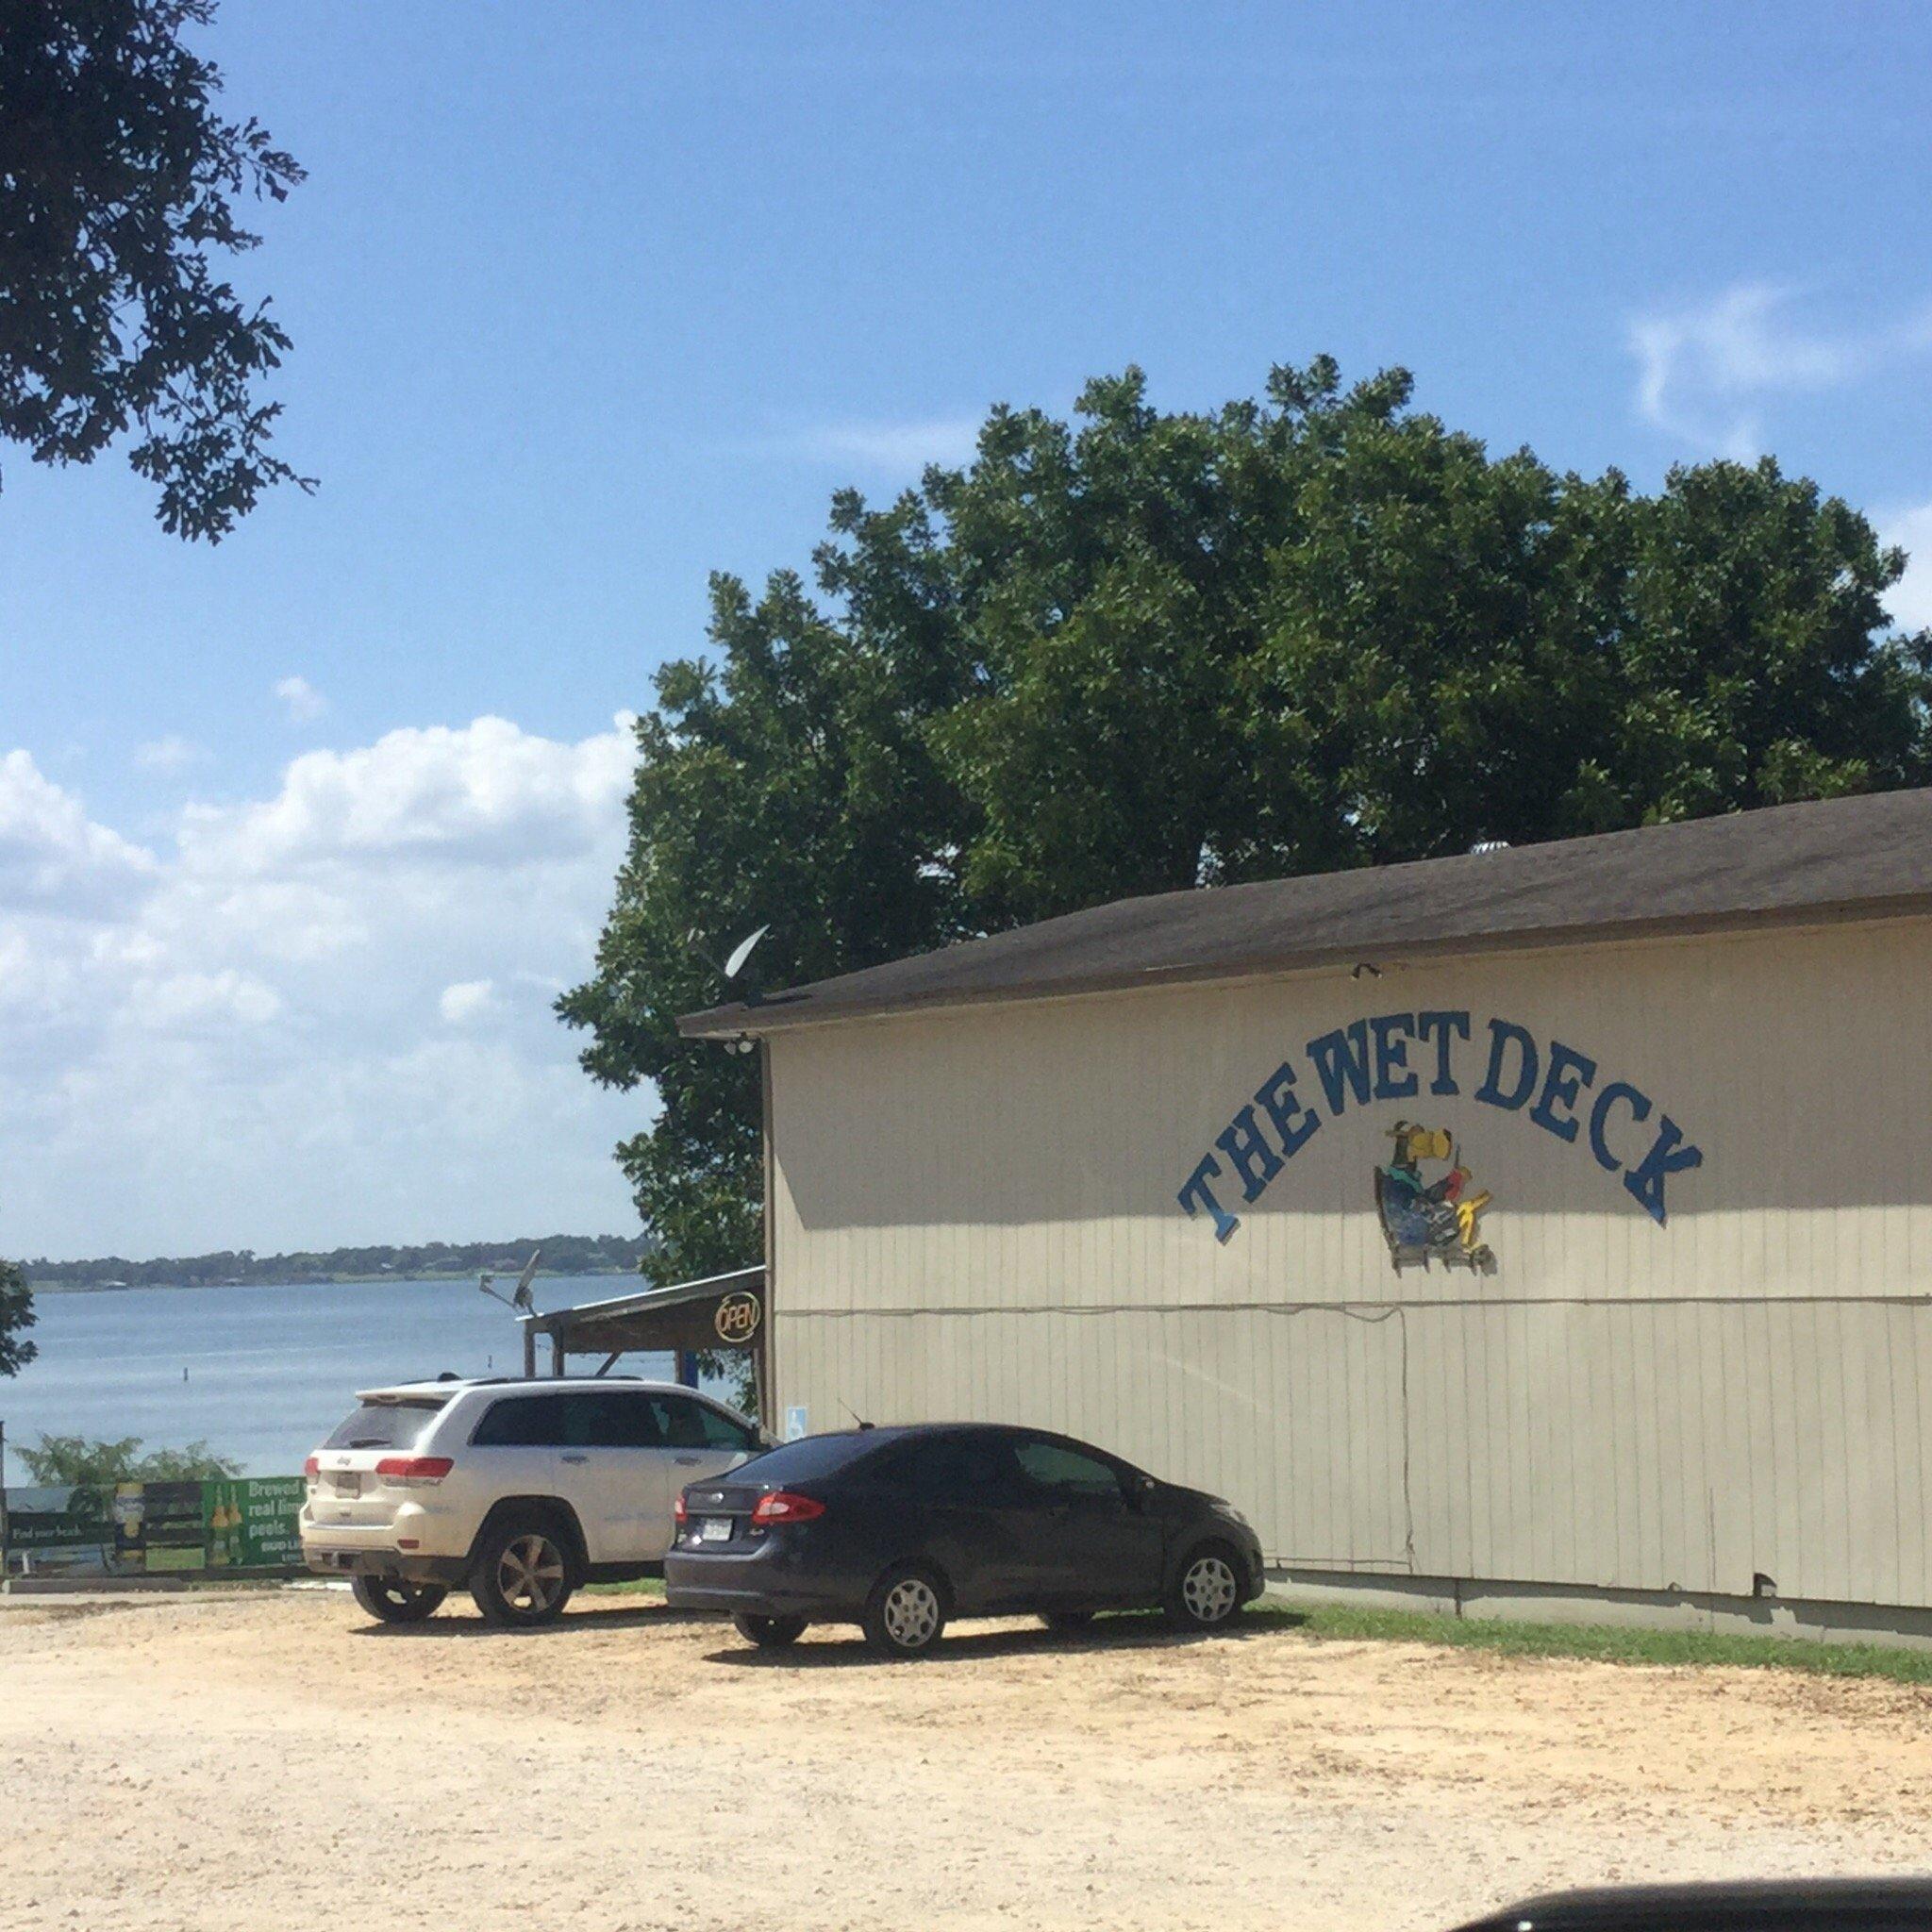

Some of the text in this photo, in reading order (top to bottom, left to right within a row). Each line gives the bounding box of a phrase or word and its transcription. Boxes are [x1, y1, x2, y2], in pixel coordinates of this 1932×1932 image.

[1176, 1010, 1704, 1246] THE WET DECK
[718, 1302, 757, 1333] OPEN
[248, 1479, 300, 1498] Brewed
[248, 1499, 275, 1517] real
